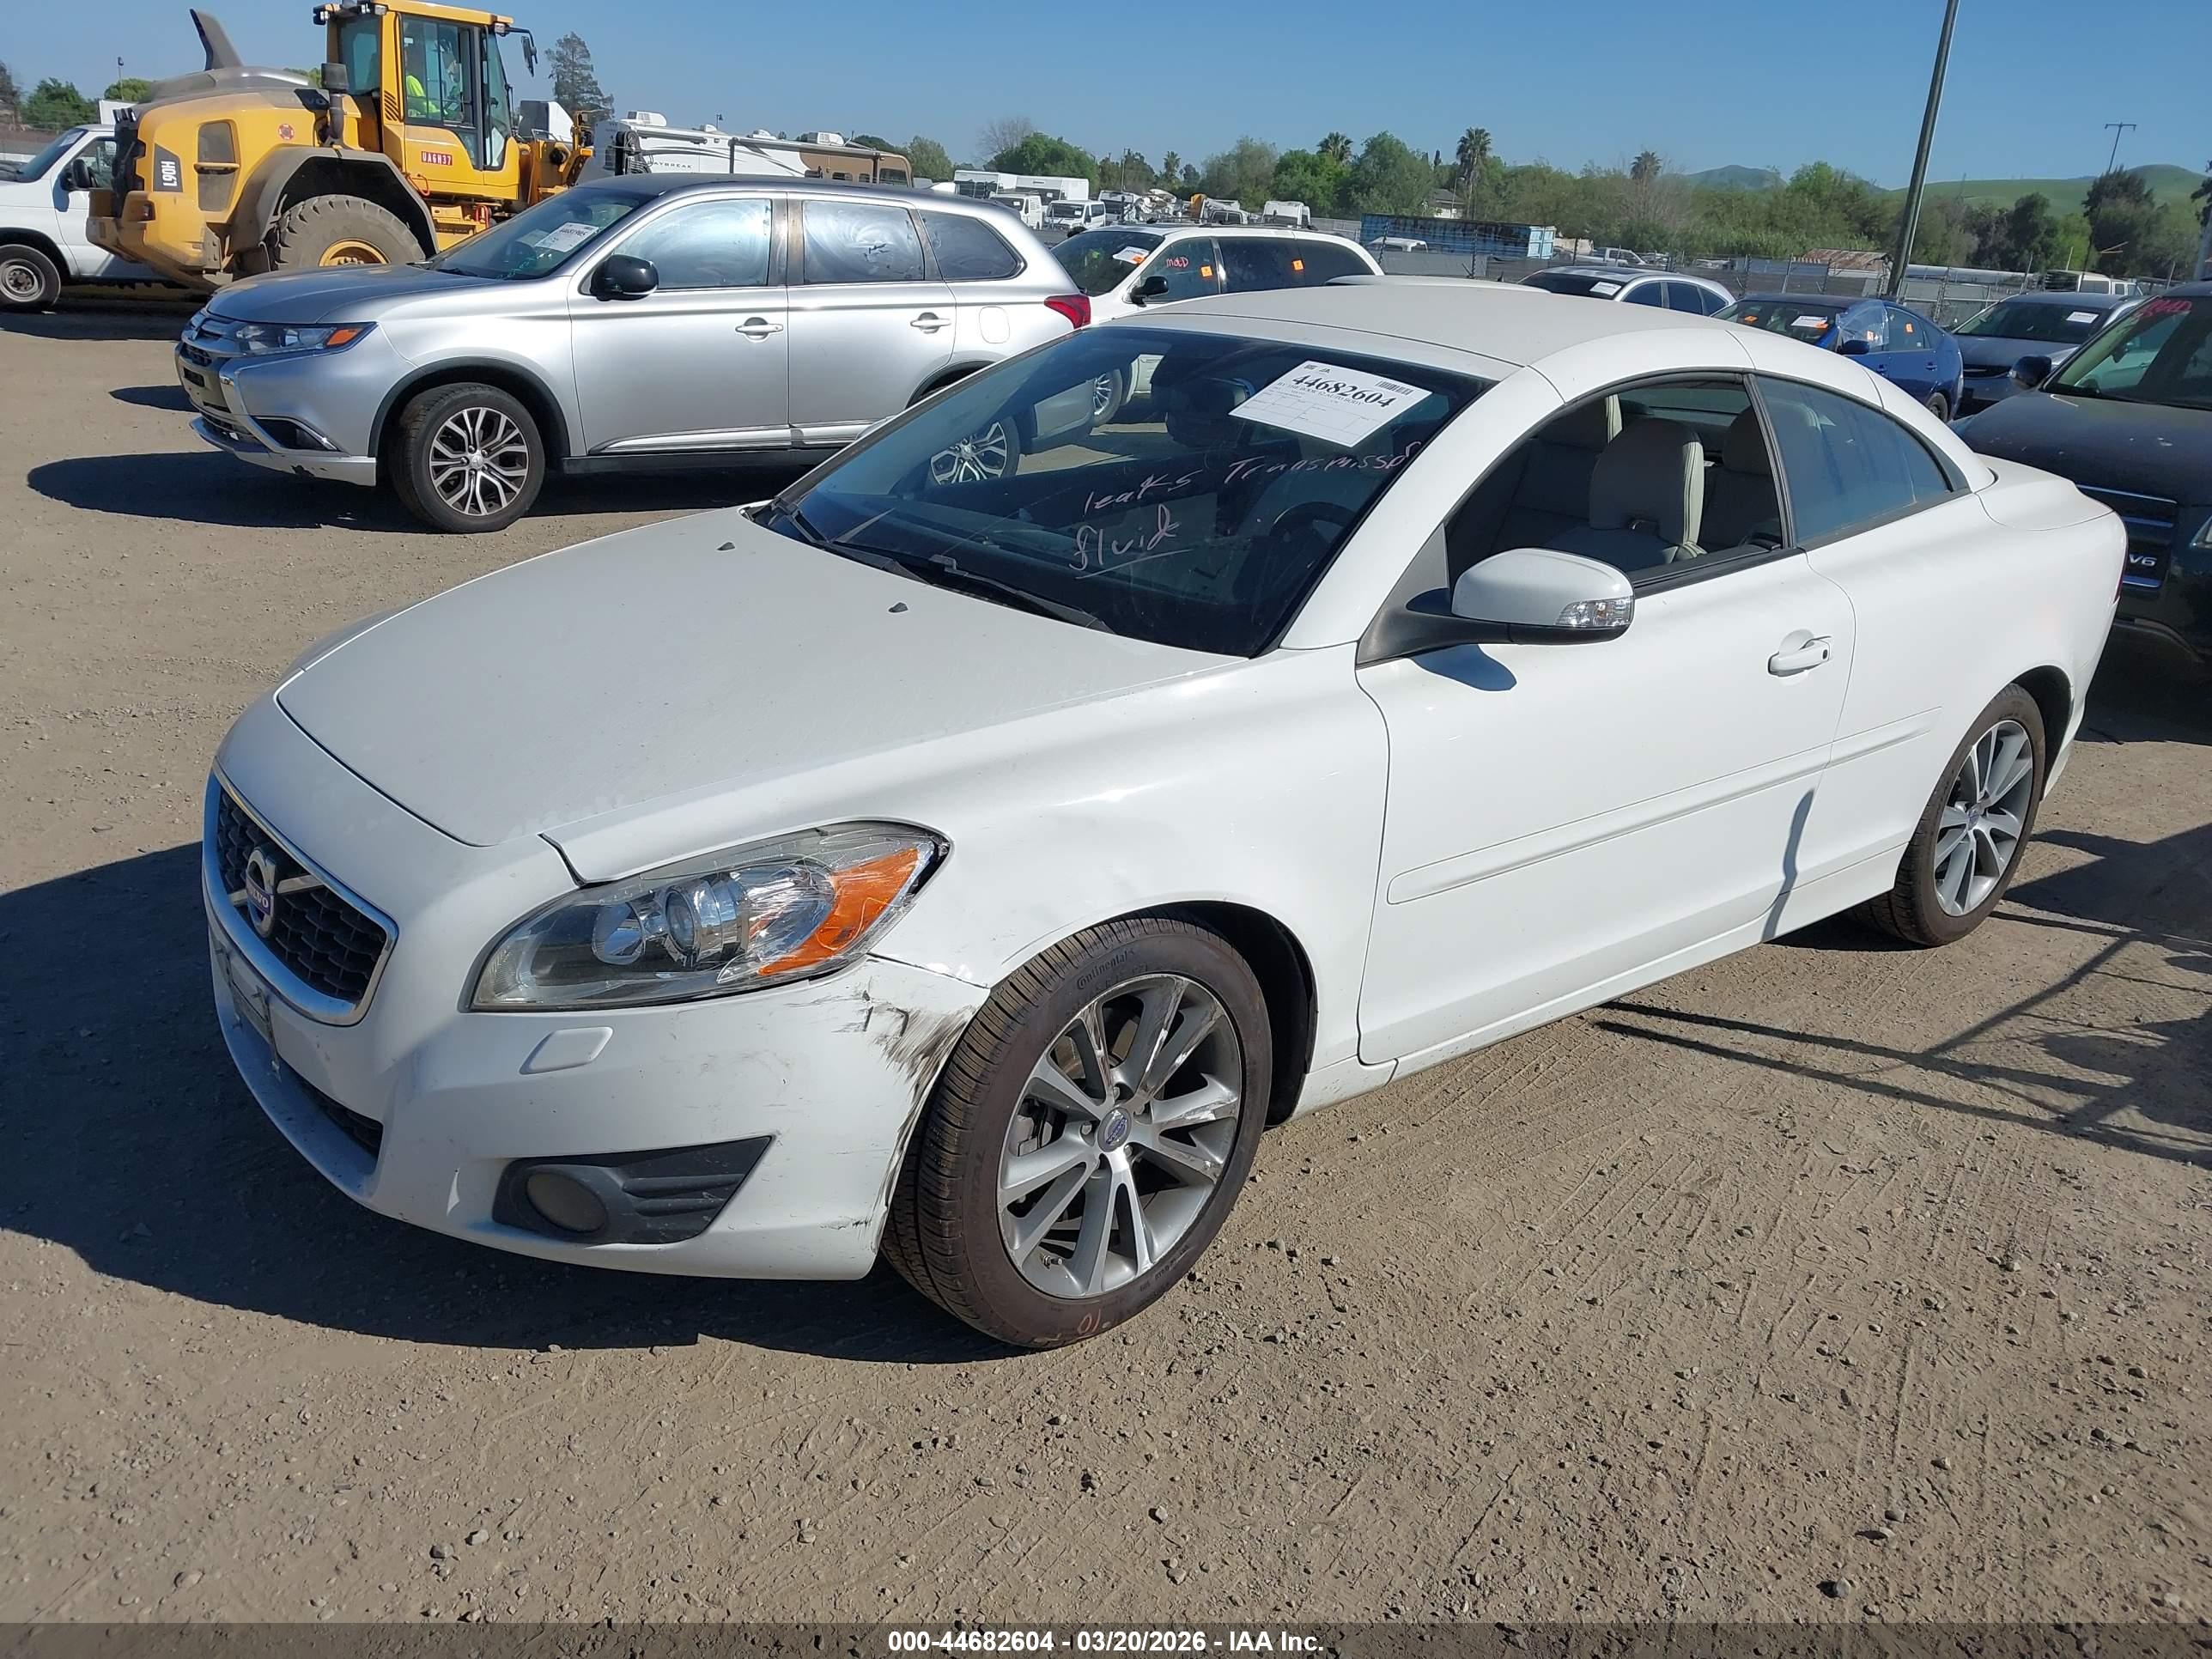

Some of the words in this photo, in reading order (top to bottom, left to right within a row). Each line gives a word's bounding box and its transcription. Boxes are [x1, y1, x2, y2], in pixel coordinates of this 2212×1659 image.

[161, 161, 178, 186] L90H
[1292, 374, 1397, 408] 44682604
[2129, 553, 2158, 567] V6
[1077, 951, 1128, 989] Continental
